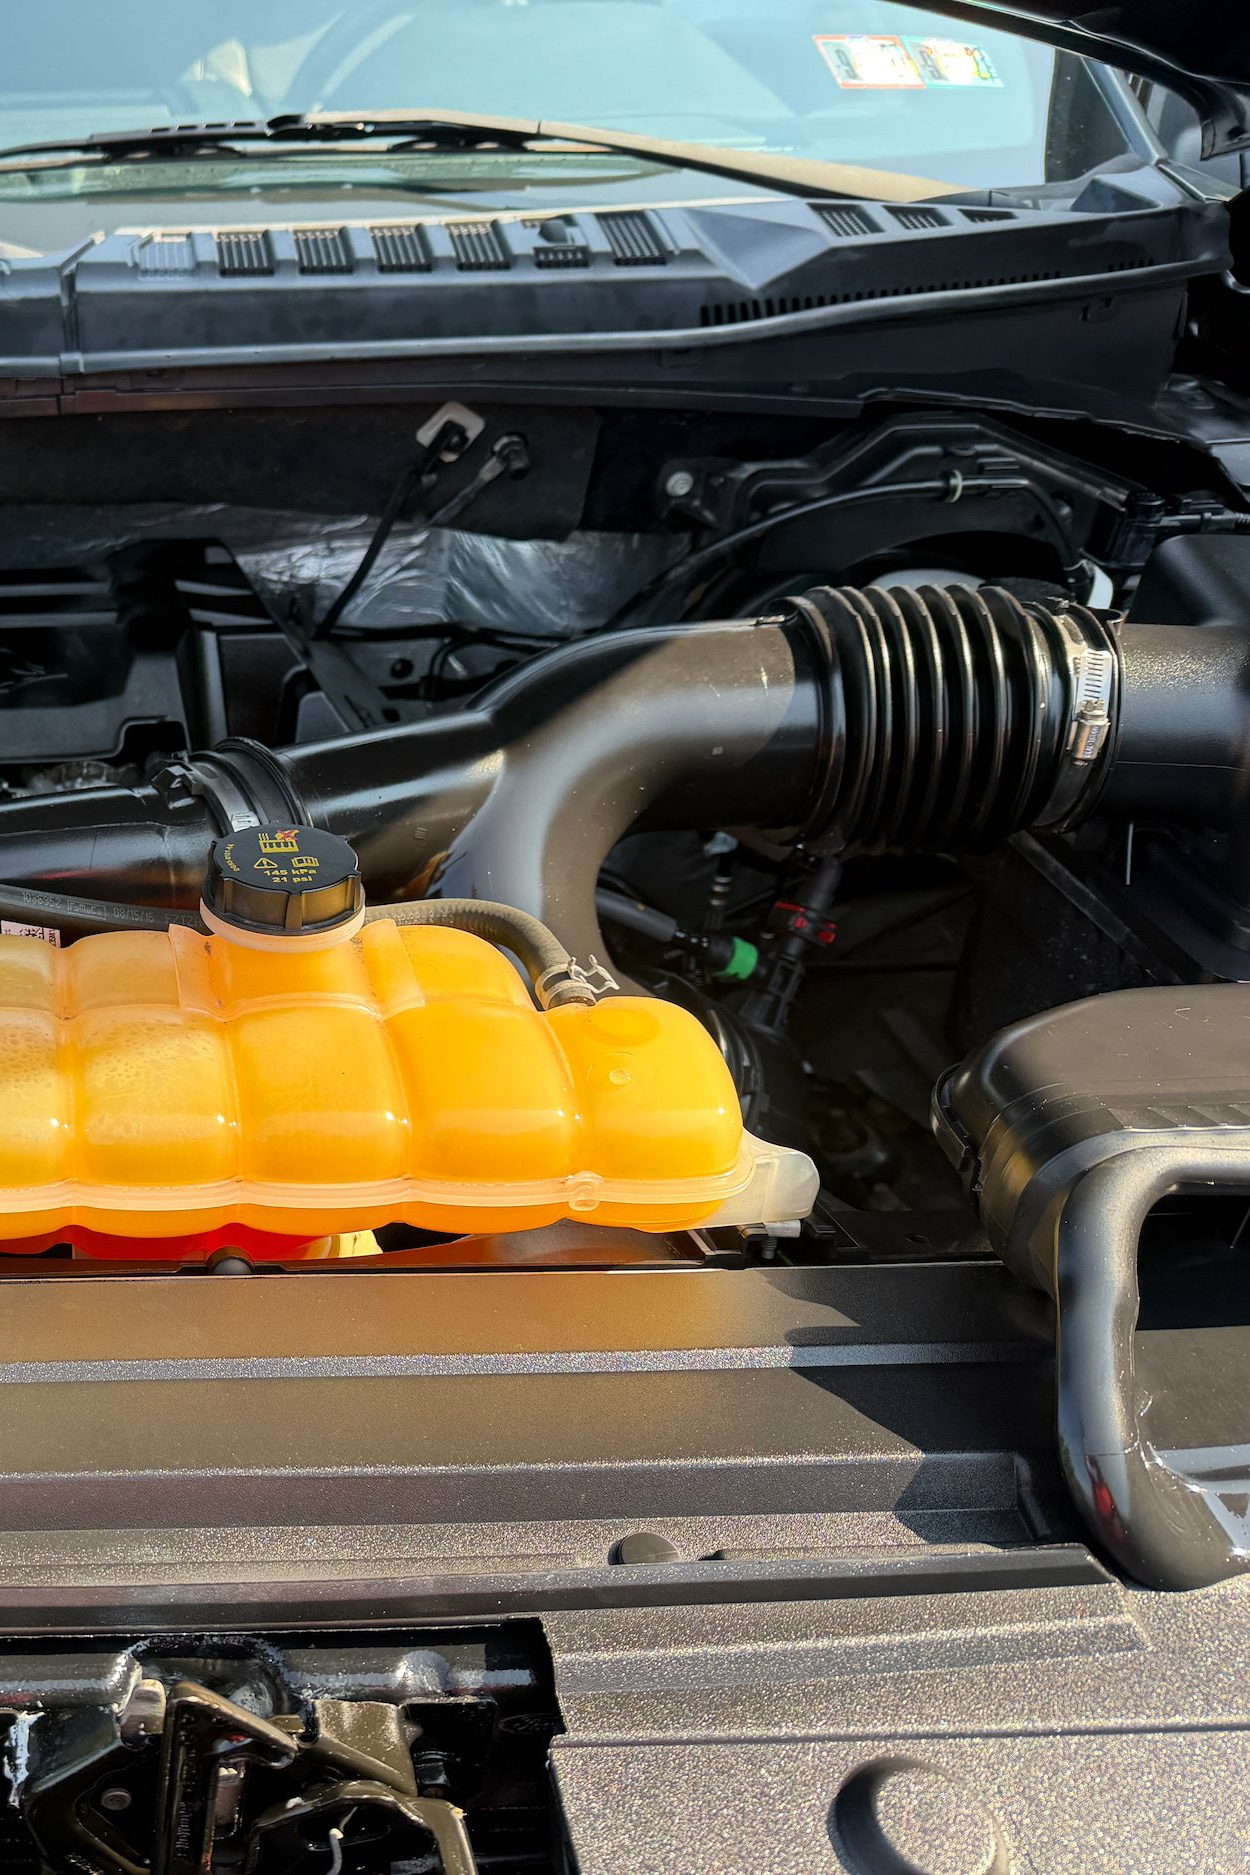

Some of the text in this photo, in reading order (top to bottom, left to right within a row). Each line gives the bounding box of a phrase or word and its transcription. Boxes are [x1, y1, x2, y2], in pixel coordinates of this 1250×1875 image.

[263, 868, 317, 877] 145 kPa
[271, 875, 313, 884] 21 psi
